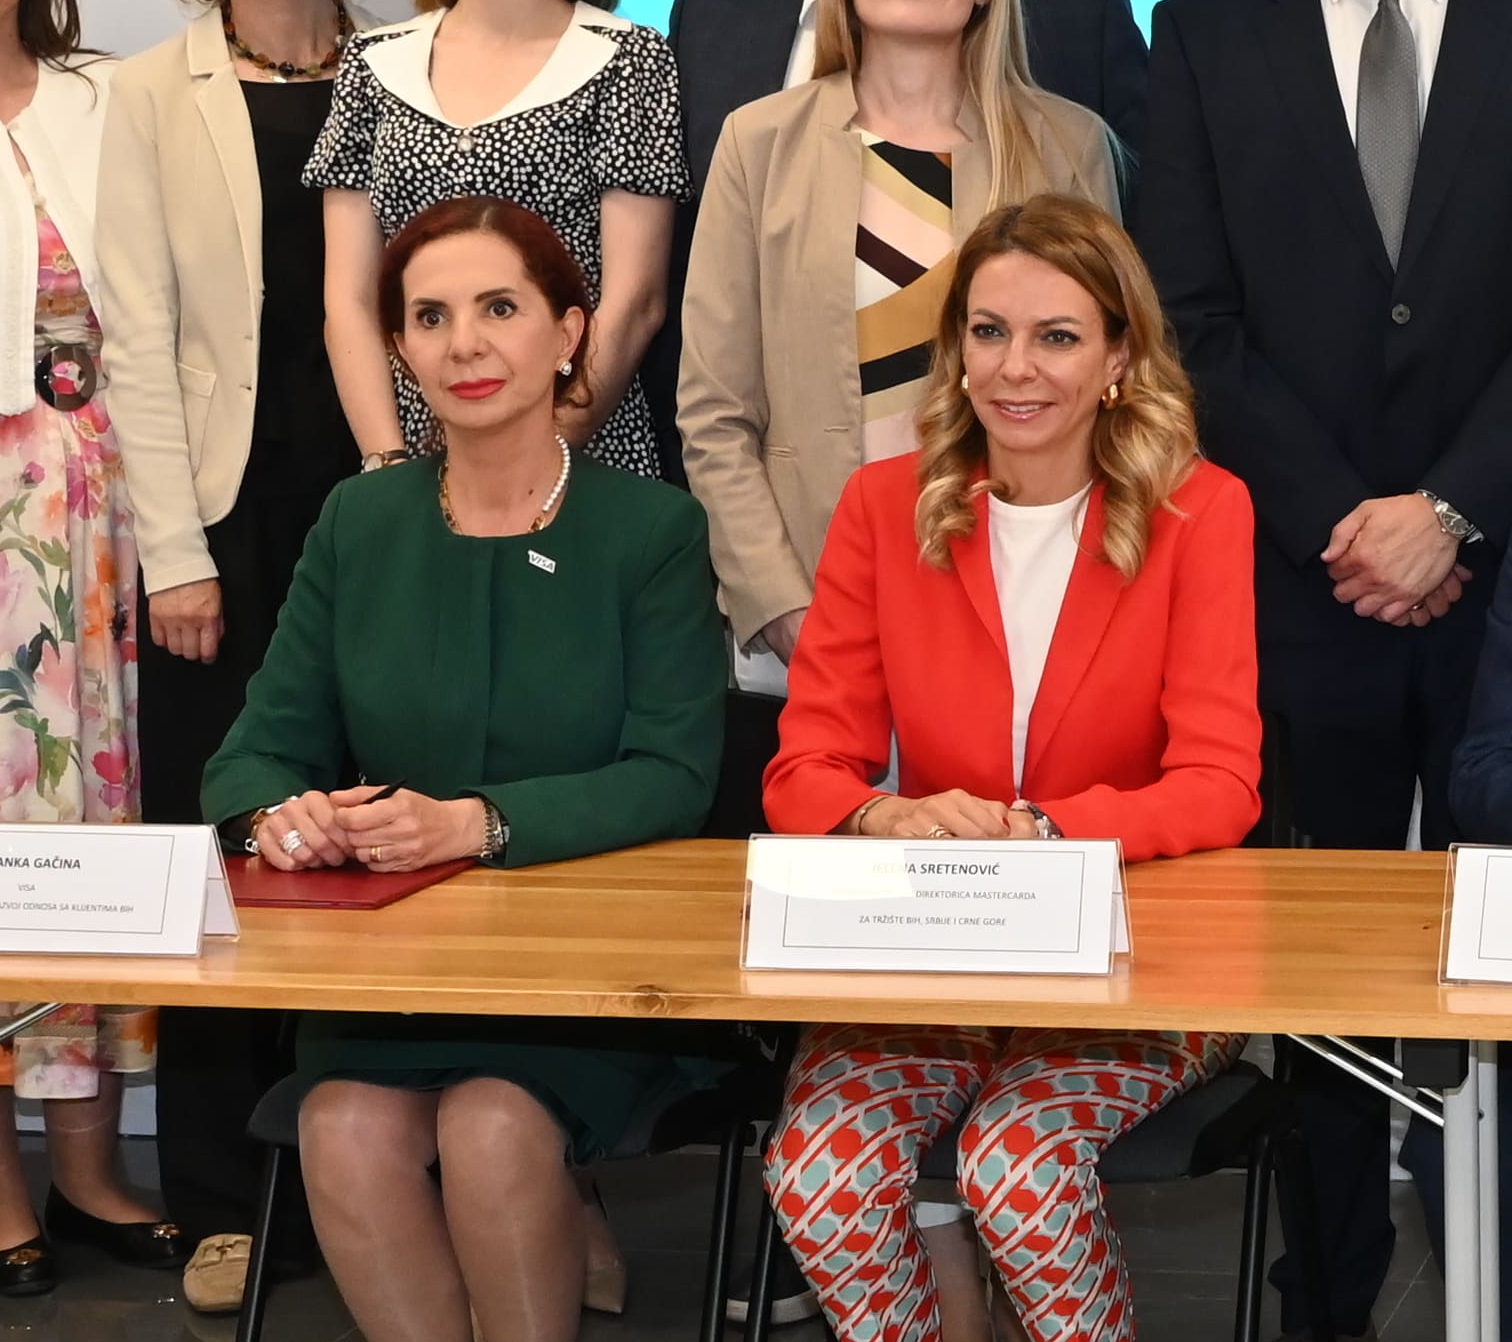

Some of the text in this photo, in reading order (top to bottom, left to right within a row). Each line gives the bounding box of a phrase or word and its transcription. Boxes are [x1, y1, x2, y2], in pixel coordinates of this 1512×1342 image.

[530, 553, 555, 571] VISA
[33, 855, 81, 870] GAČINA
[919, 861, 1000, 876] SRETENOVIĆ
[17, 883, 36, 892] VISA
[915, 890, 1037, 900] DIREKTORICA MASTERCARDA
[858, 915, 870, 924] ZA
